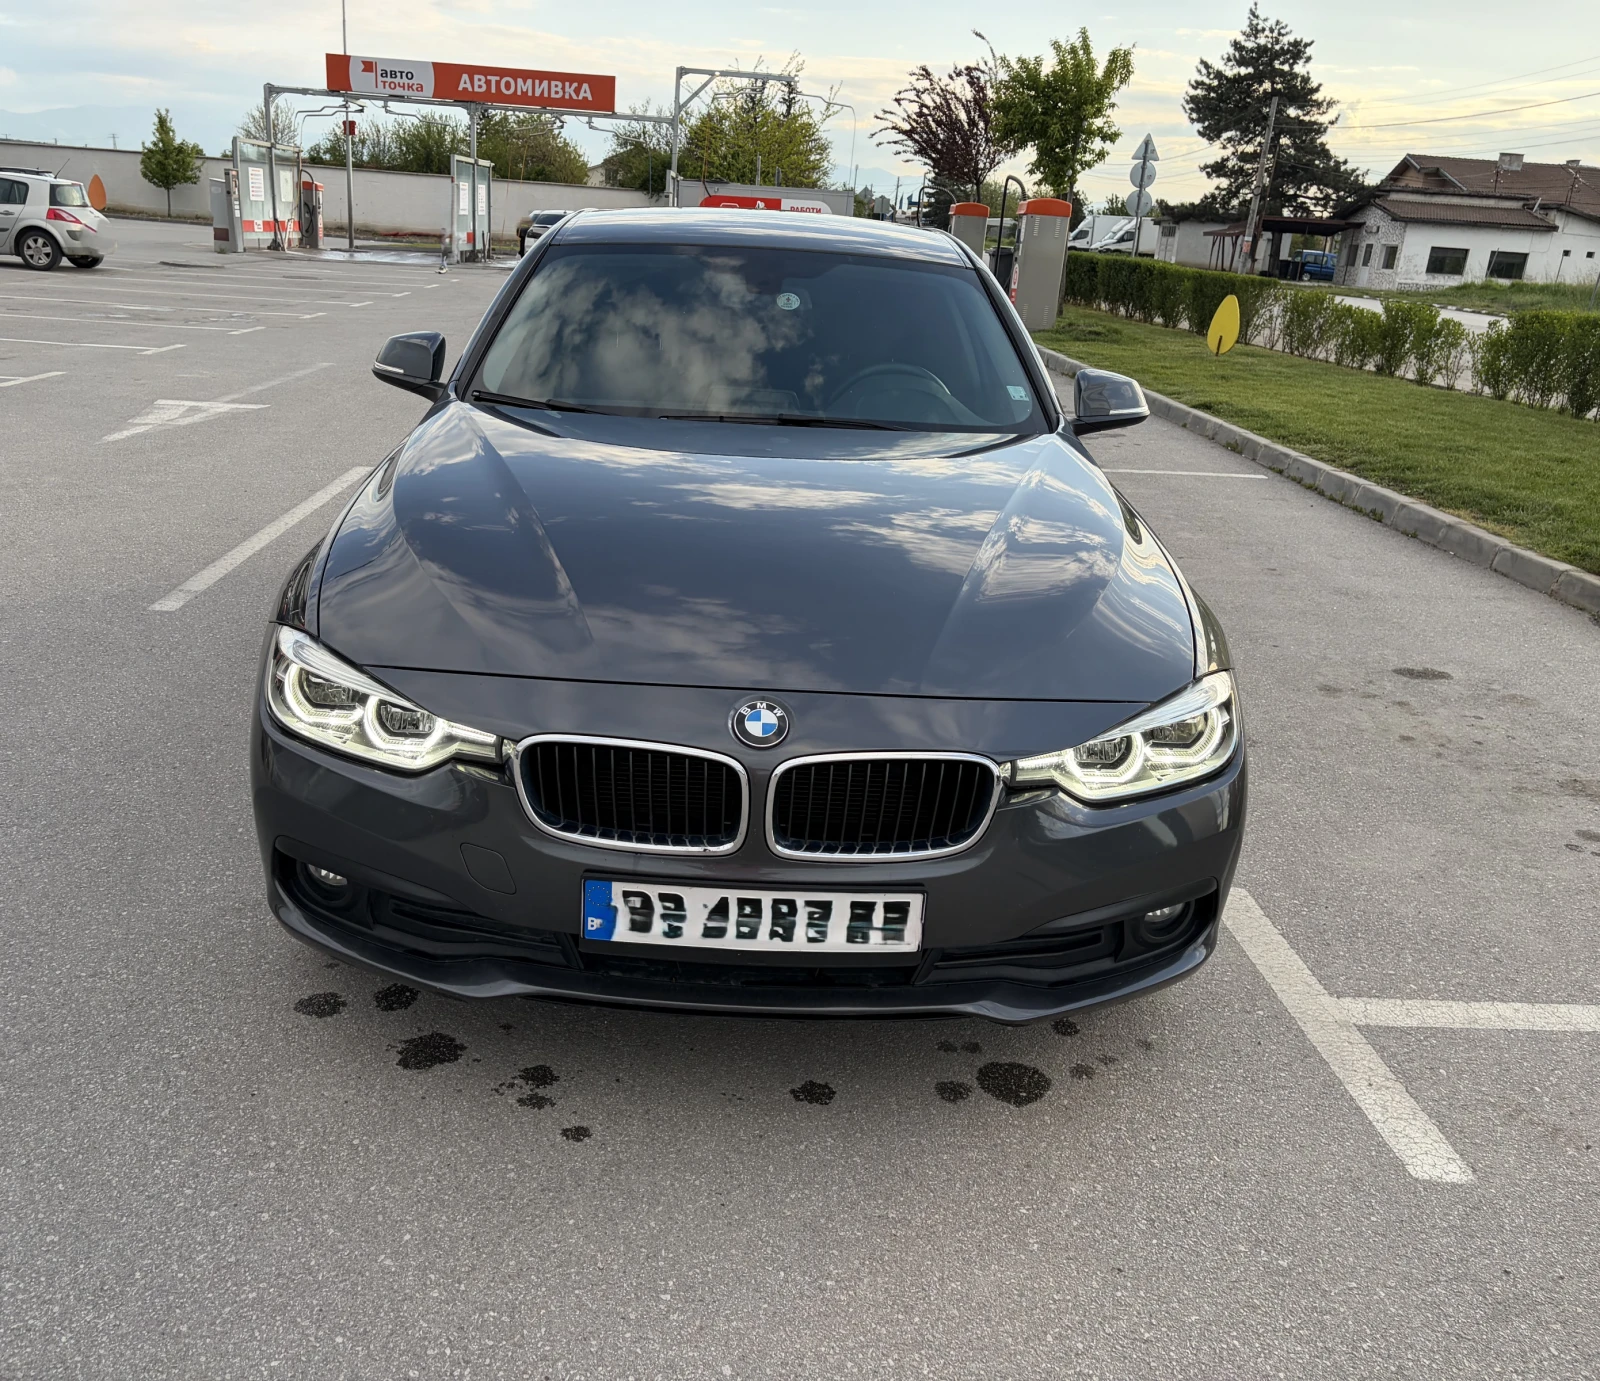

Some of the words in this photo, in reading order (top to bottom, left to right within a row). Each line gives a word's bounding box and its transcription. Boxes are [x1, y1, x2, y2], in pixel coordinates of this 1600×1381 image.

[380, 68, 414, 81] авто
[380, 80, 424, 92] точка
[458, 73, 593, 100] АВТОМИВКА
[740, 702, 784, 717] BMW
